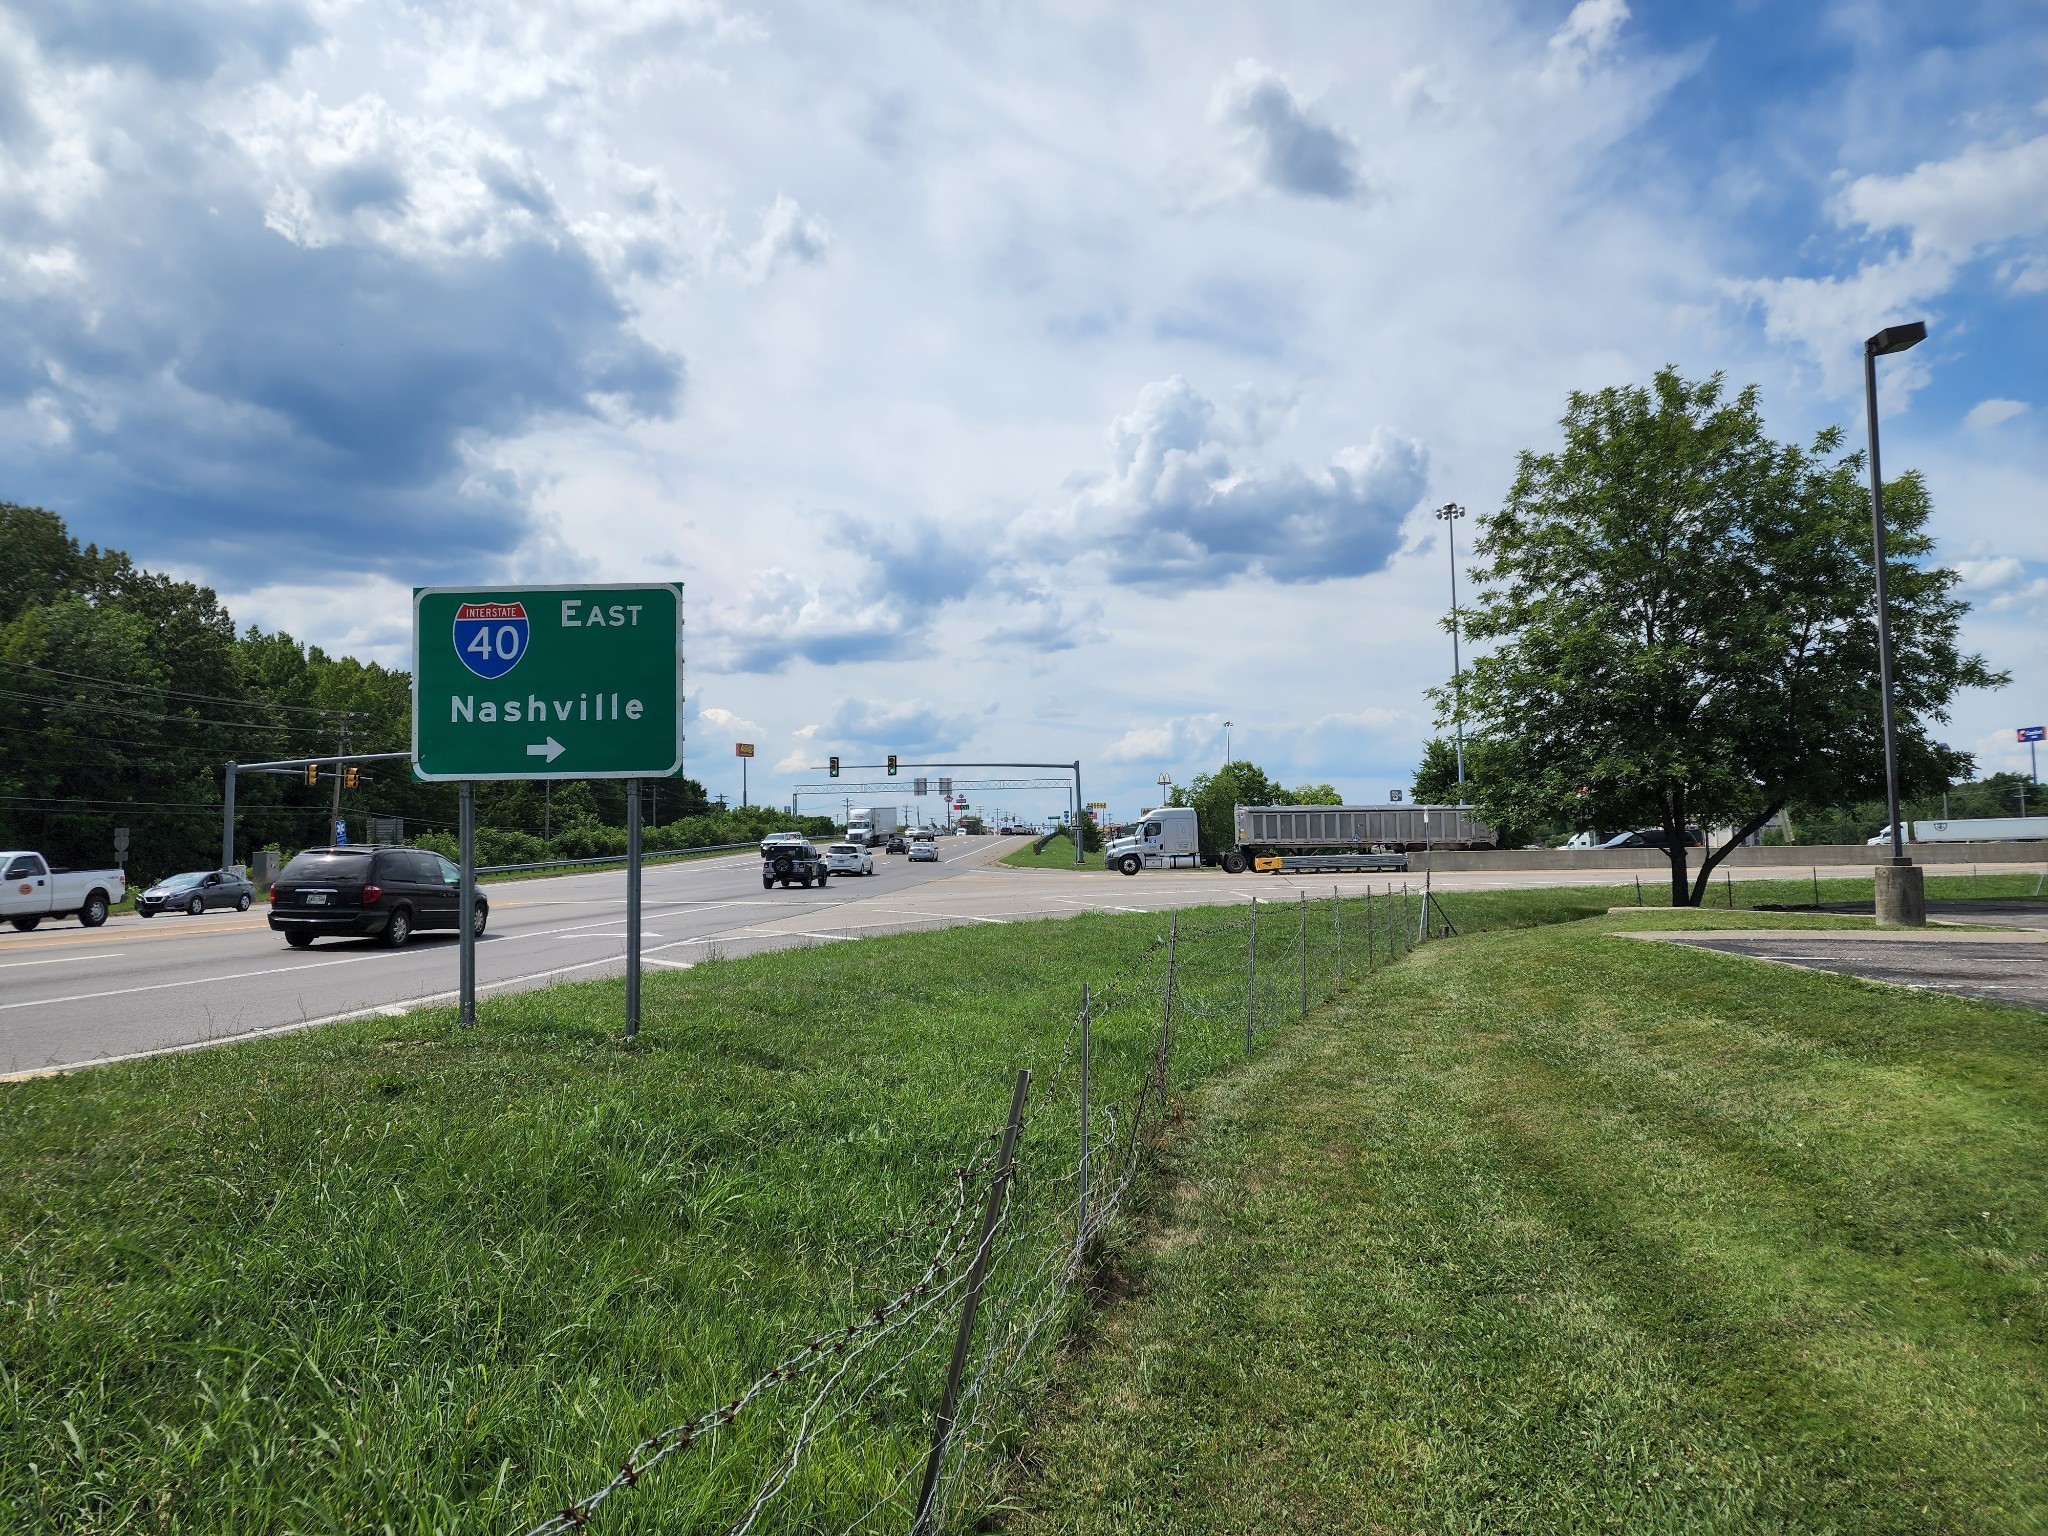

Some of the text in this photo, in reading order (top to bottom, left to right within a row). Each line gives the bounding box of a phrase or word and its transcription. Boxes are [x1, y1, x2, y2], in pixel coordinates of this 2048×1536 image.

[466, 607, 517, 618] INTERSTATE
[467, 626, 519, 660] 40
[451, 692, 644, 723] Nashville
